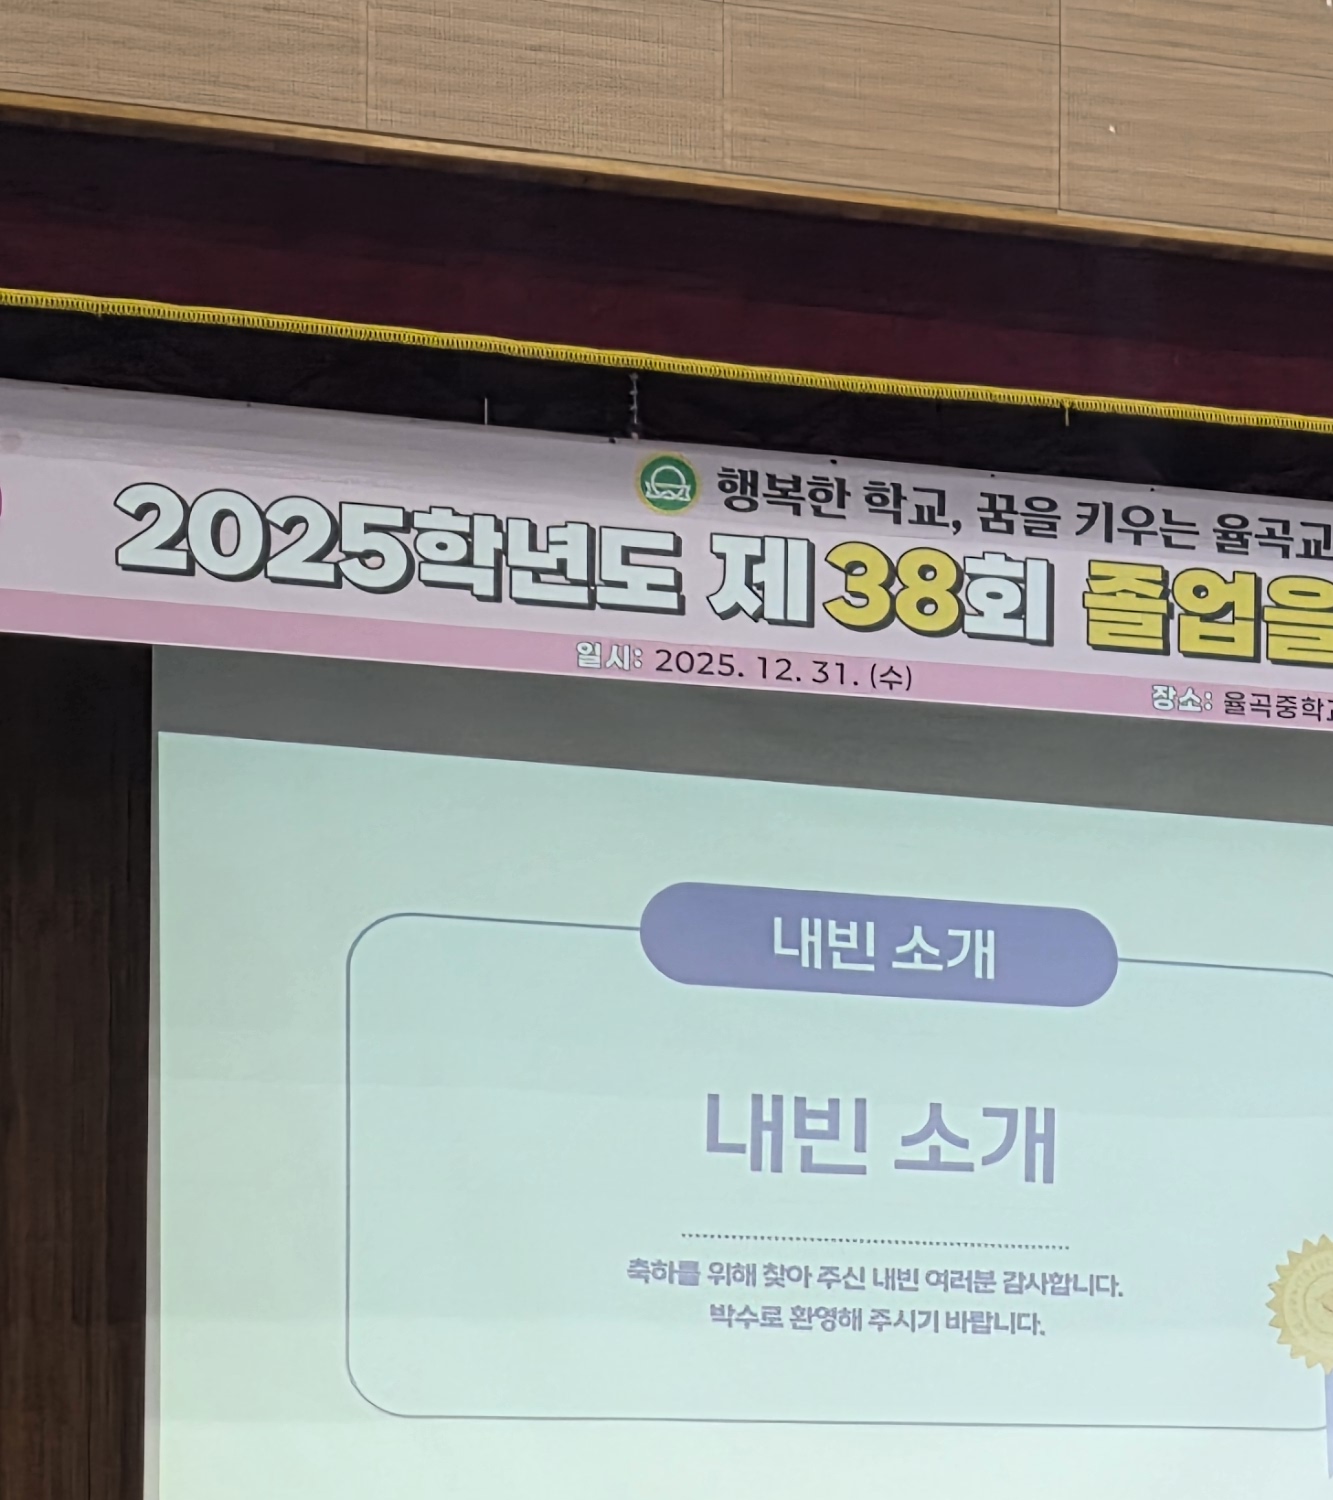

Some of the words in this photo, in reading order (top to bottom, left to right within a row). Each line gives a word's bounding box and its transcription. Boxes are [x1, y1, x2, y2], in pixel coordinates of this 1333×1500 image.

[716, 466, 852, 520] 행복한
[862, 479, 962, 536] 학교,
[975, 490, 1061, 540] 꿈을
[1074, 500, 1200, 552] 키우는
[113, 481, 686, 617] 2025학년도
[706, 531, 1055, 648] 제38회
[575, 640, 644, 671] 일시:
[654, 648, 745, 679] 2025.
[757, 655, 802, 682] 12.
[811, 659, 859, 687] 31.
[869, 662, 913, 693] (수)
[1151, 684, 1214, 713] 장소:
[773, 916, 876, 972] 내빈
[891, 924, 996, 980] 소개
[706, 1092, 868, 1176] 내빈
[893, 1101, 1057, 1185] 소개
[626, 1257, 701, 1287] 축하를
[706, 1260, 758, 1289] 위해
[762, 1263, 812, 1290] 찾아
[816, 1264, 866, 1292] 주신
[871, 1266, 920, 1293] 내빈
[924, 1266, 998, 1294] 여러분
[1002, 1269, 1125, 1298] 감사합니다.
[708, 1303, 785, 1330] 박수로
[789, 1305, 864, 1333] 환영해
[867, 1307, 941, 1335] 주시기
[945, 1310, 1047, 1337] 바랍니다.
